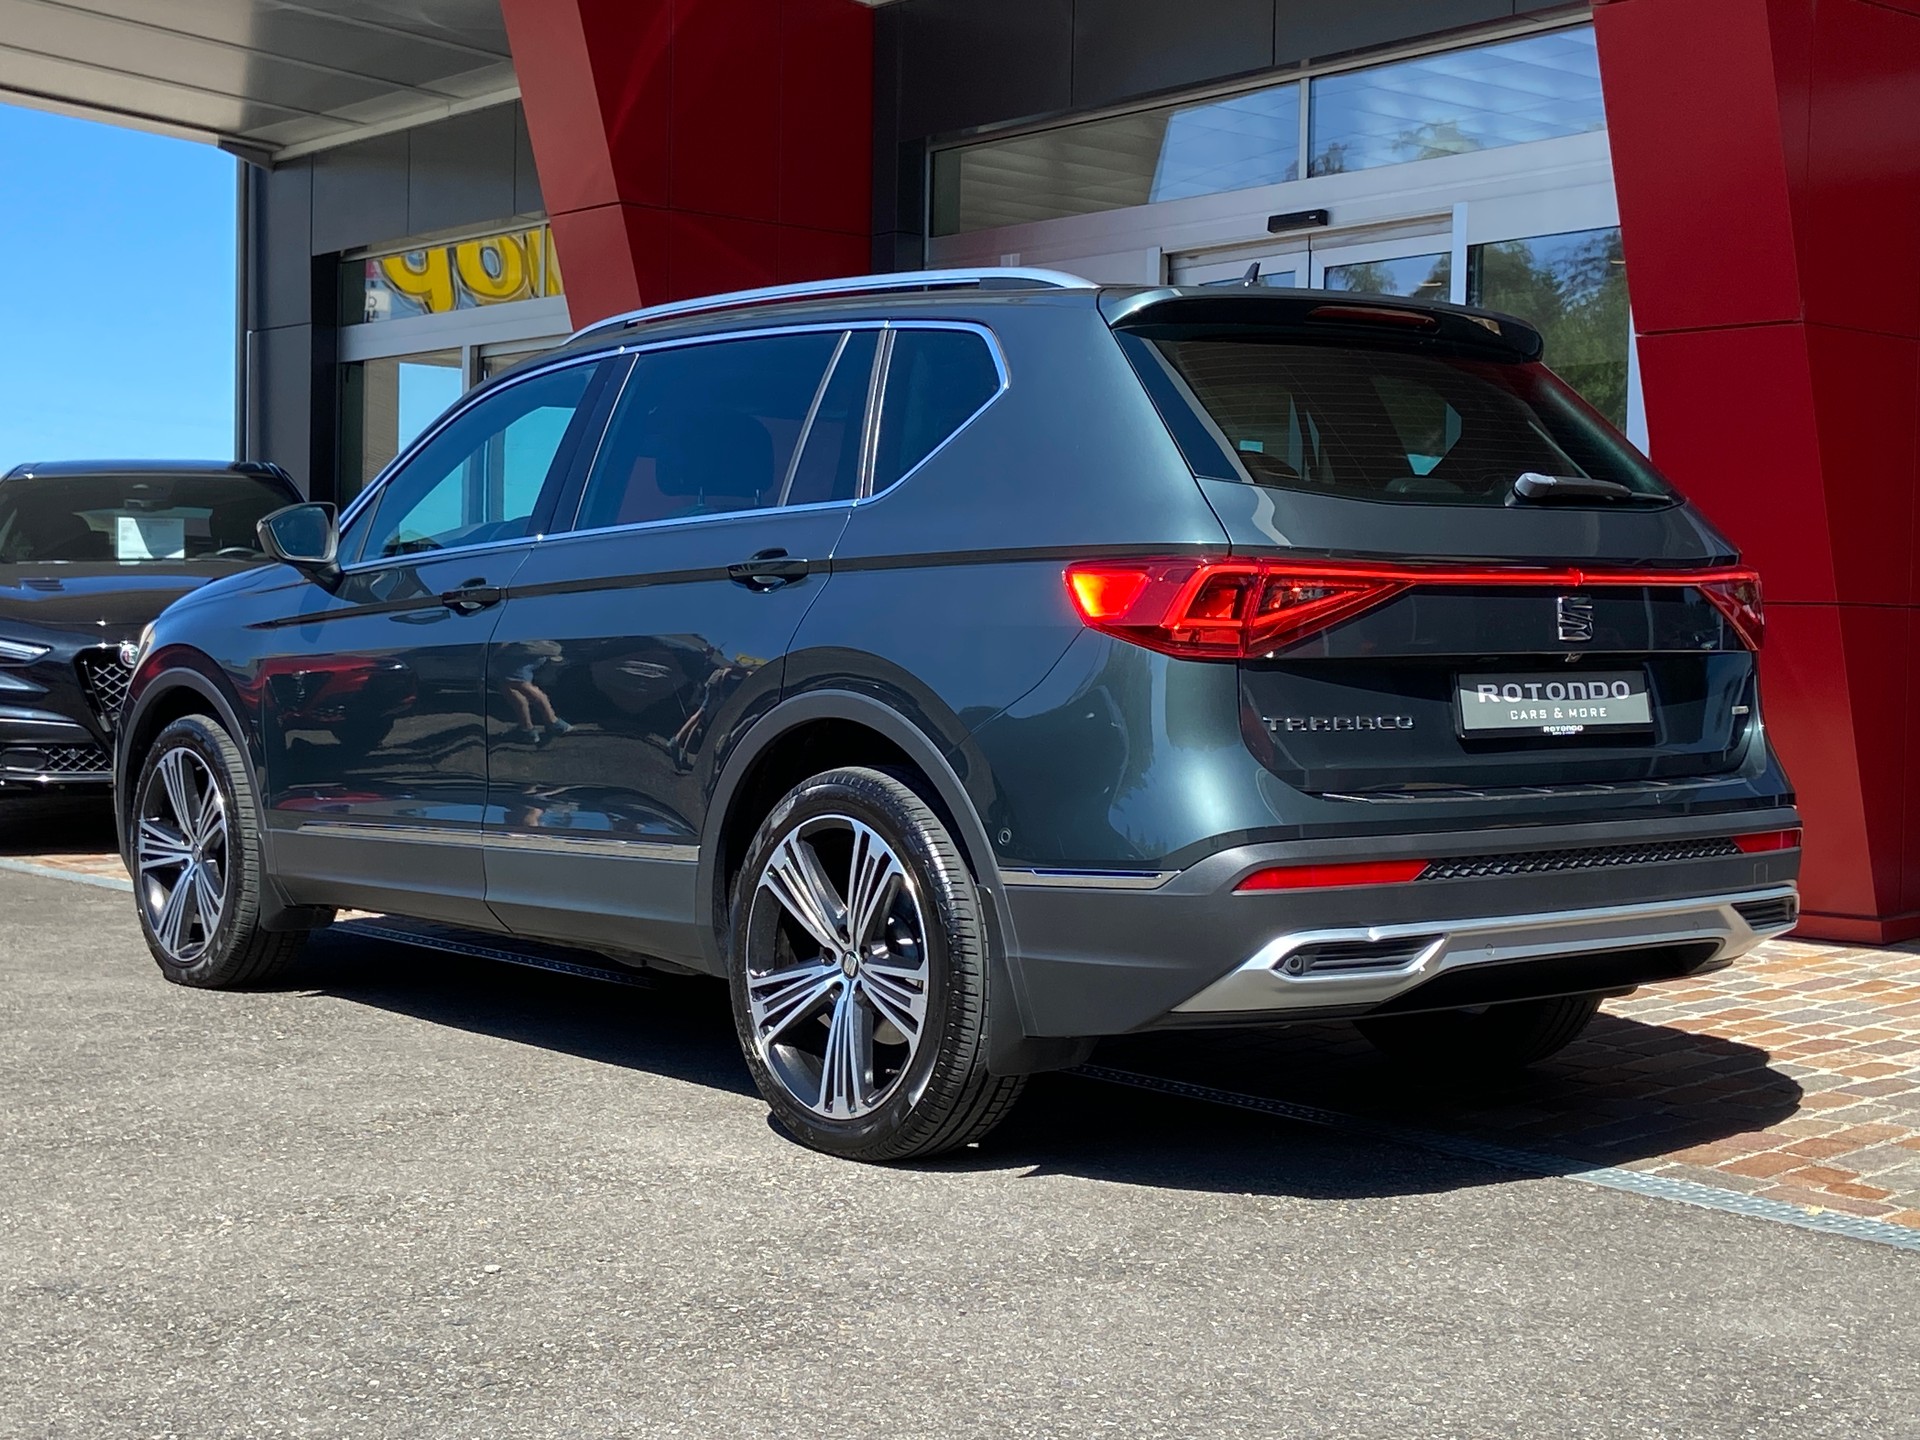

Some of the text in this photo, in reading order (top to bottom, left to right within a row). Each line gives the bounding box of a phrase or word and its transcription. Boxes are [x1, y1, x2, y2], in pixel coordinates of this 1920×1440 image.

[1477, 680, 1631, 703] ROTONDO
[1510, 707, 1608, 720] CARS & MORE
[1262, 715, 1414, 731] TARRACO
